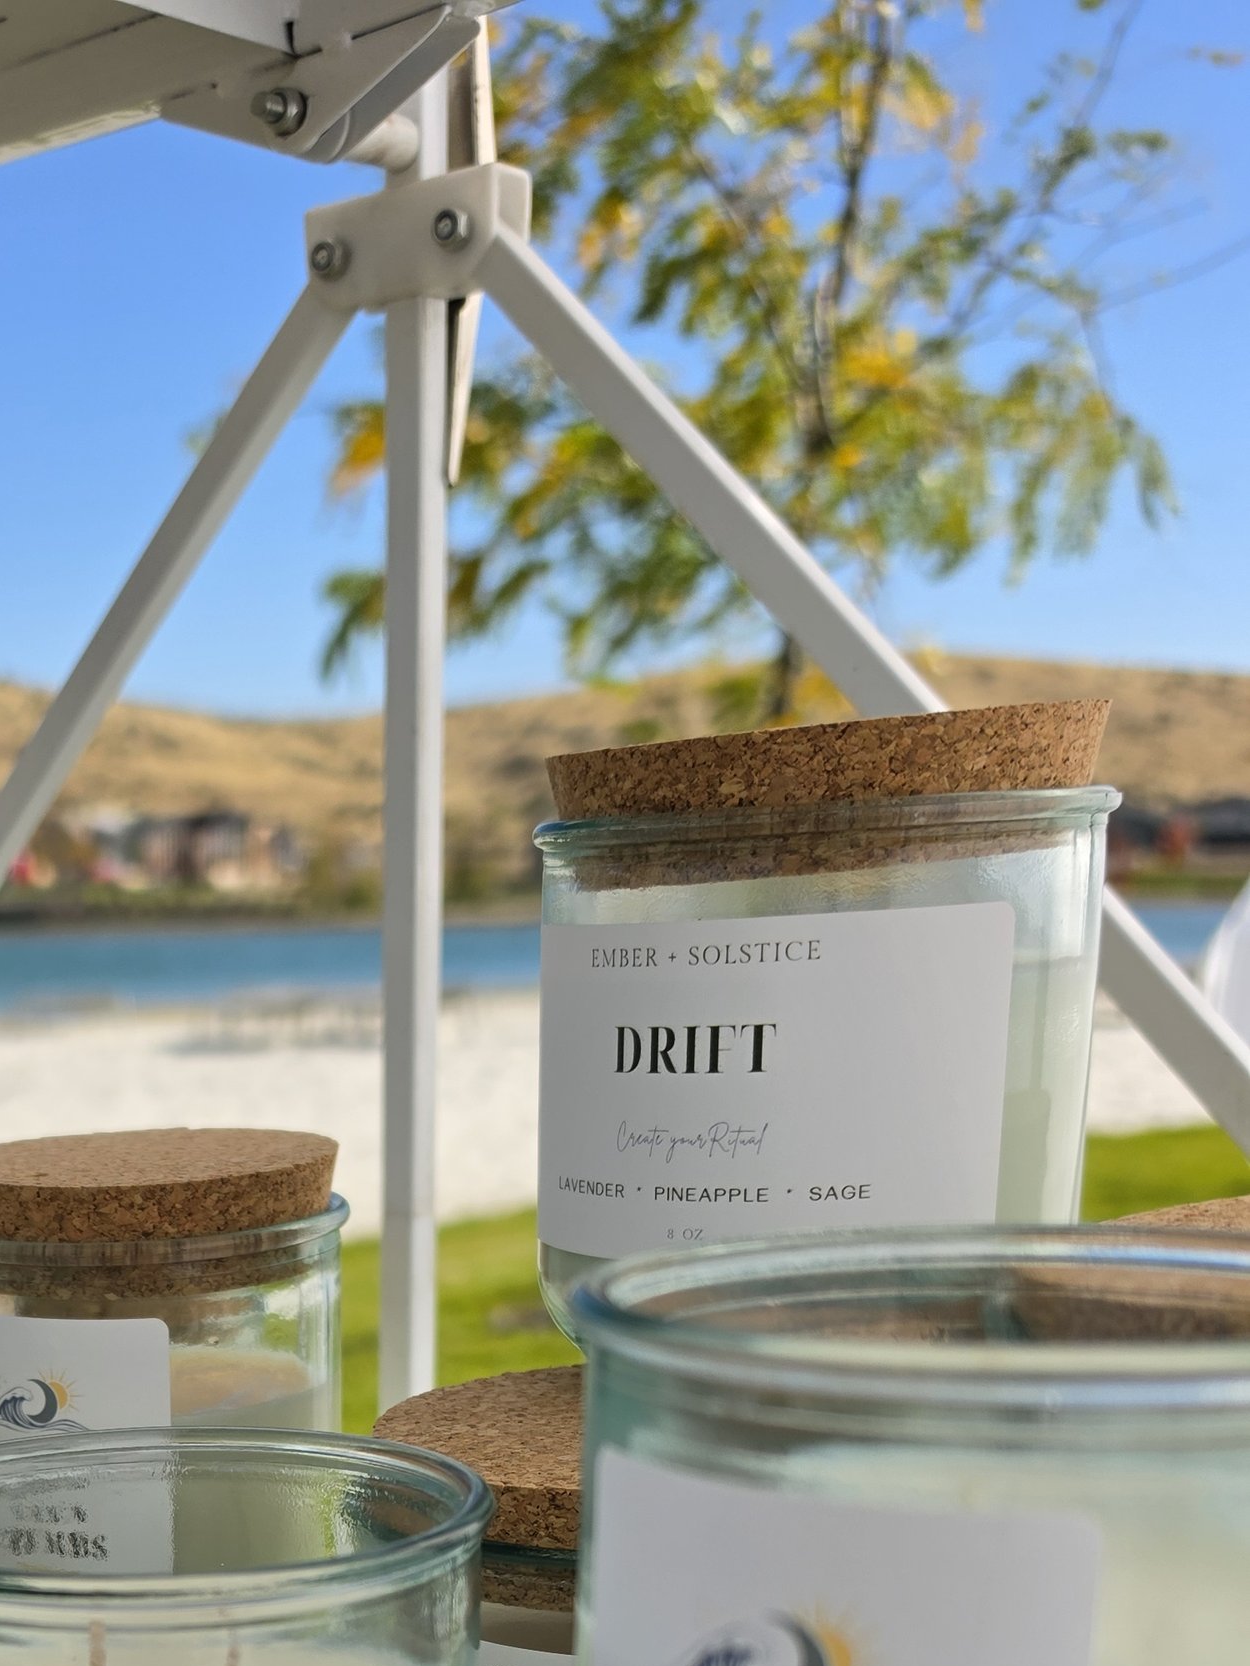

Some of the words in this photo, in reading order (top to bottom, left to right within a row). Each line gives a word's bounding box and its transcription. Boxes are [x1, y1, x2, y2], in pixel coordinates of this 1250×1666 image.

[591, 946, 658, 969] EMBER
[688, 940, 823, 967] SOLSTICE
[613, 1022, 778, 1075] DRIFT
[616, 1120, 669, 1158] Create
[666, 1135, 707, 1164] your
[706, 1121, 769, 1159] Ritual
[558, 1175, 626, 1198] LAVENDER
[653, 1186, 770, 1203] PINEAPPLE
[809, 1183, 873, 1202] SAGE
[666, 1228, 674, 1240] 8
[682, 1228, 704, 1241] OZ
